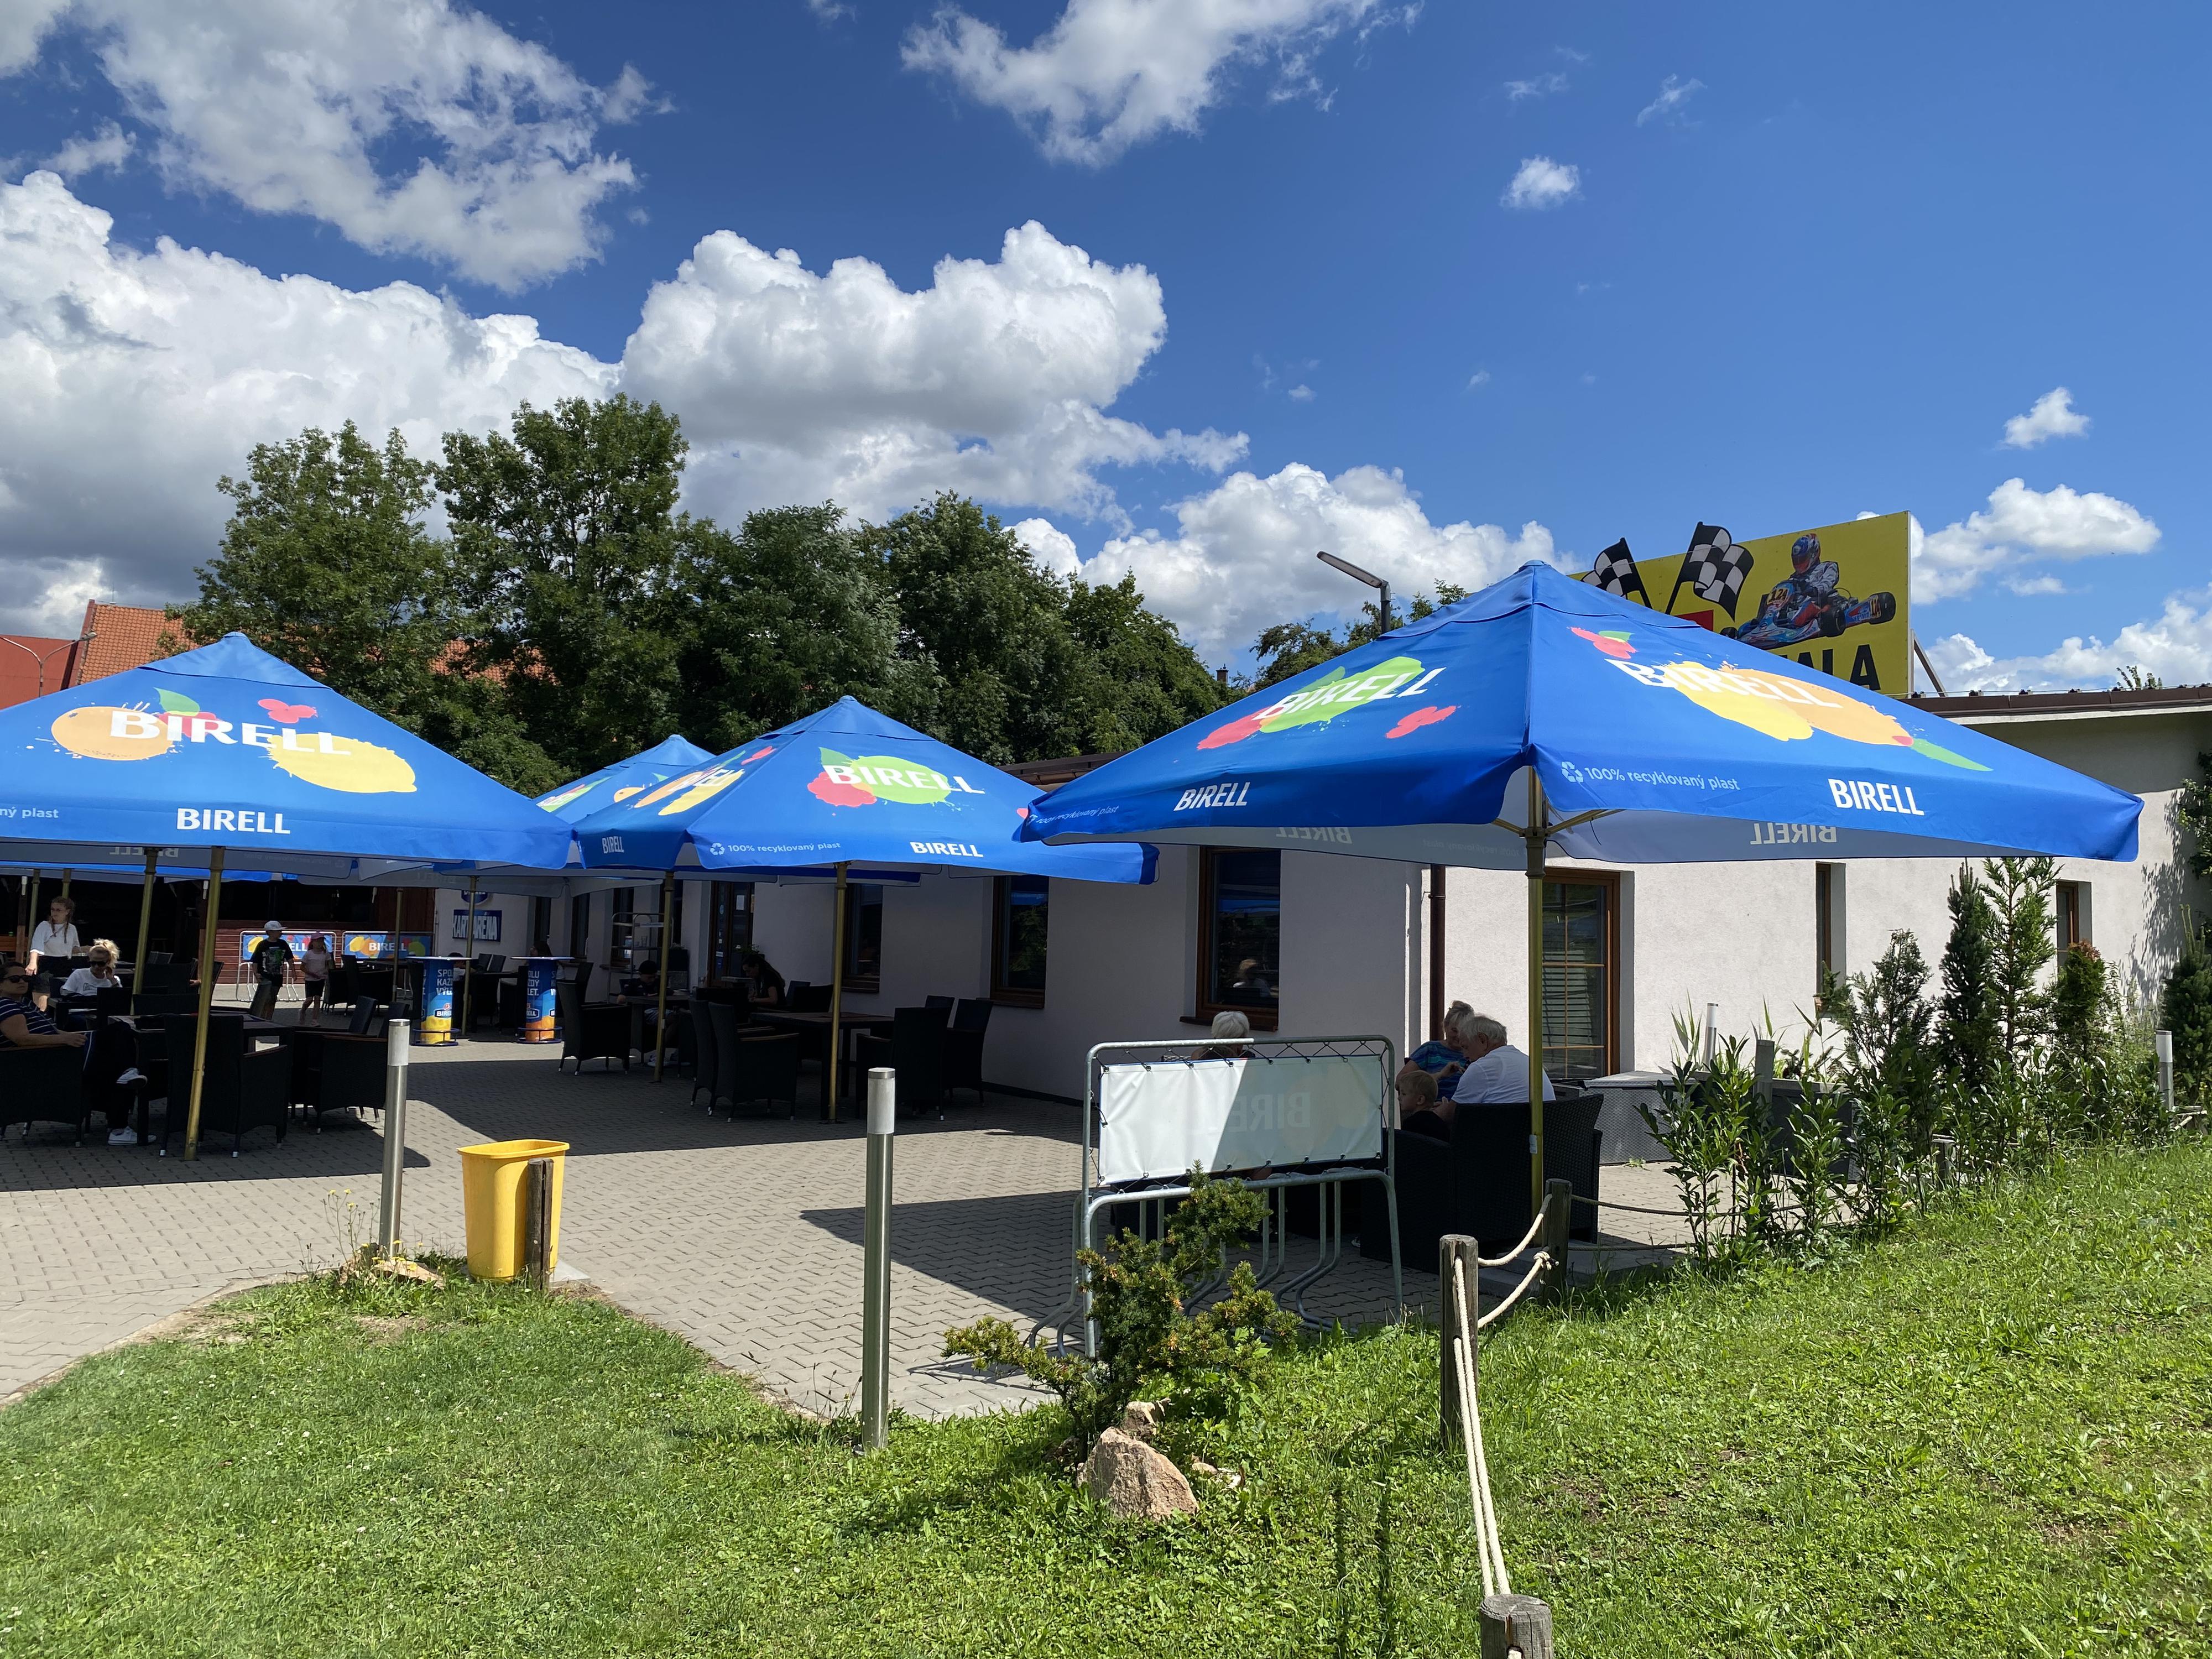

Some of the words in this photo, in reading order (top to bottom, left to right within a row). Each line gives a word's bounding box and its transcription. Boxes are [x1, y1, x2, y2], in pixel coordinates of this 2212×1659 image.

[1252, 667, 1447, 721] BIRELL
[1604, 659, 1843, 708] BIRELL
[111, 711, 351, 755] BIRELL
[822, 765, 985, 794] BIRELL
[1584, 767, 1626, 781] 100%
[1626, 770, 1705, 790] recyklovaný
[1708, 776, 1740, 790] plast
[1173, 781, 1250, 811] BIRELL
[1828, 778, 1925, 816] BIRELL
[22, 807, 59, 818] plast
[176, 807, 290, 834] BIRELL
[1098, 805, 1119, 816] plast
[602, 836, 624, 853] BIRELL
[757, 843, 815, 853] recyklovaný
[817, 842, 841, 851] plast
[909, 841, 984, 858] BIRELL
[369, 942, 407, 951] BIREL
